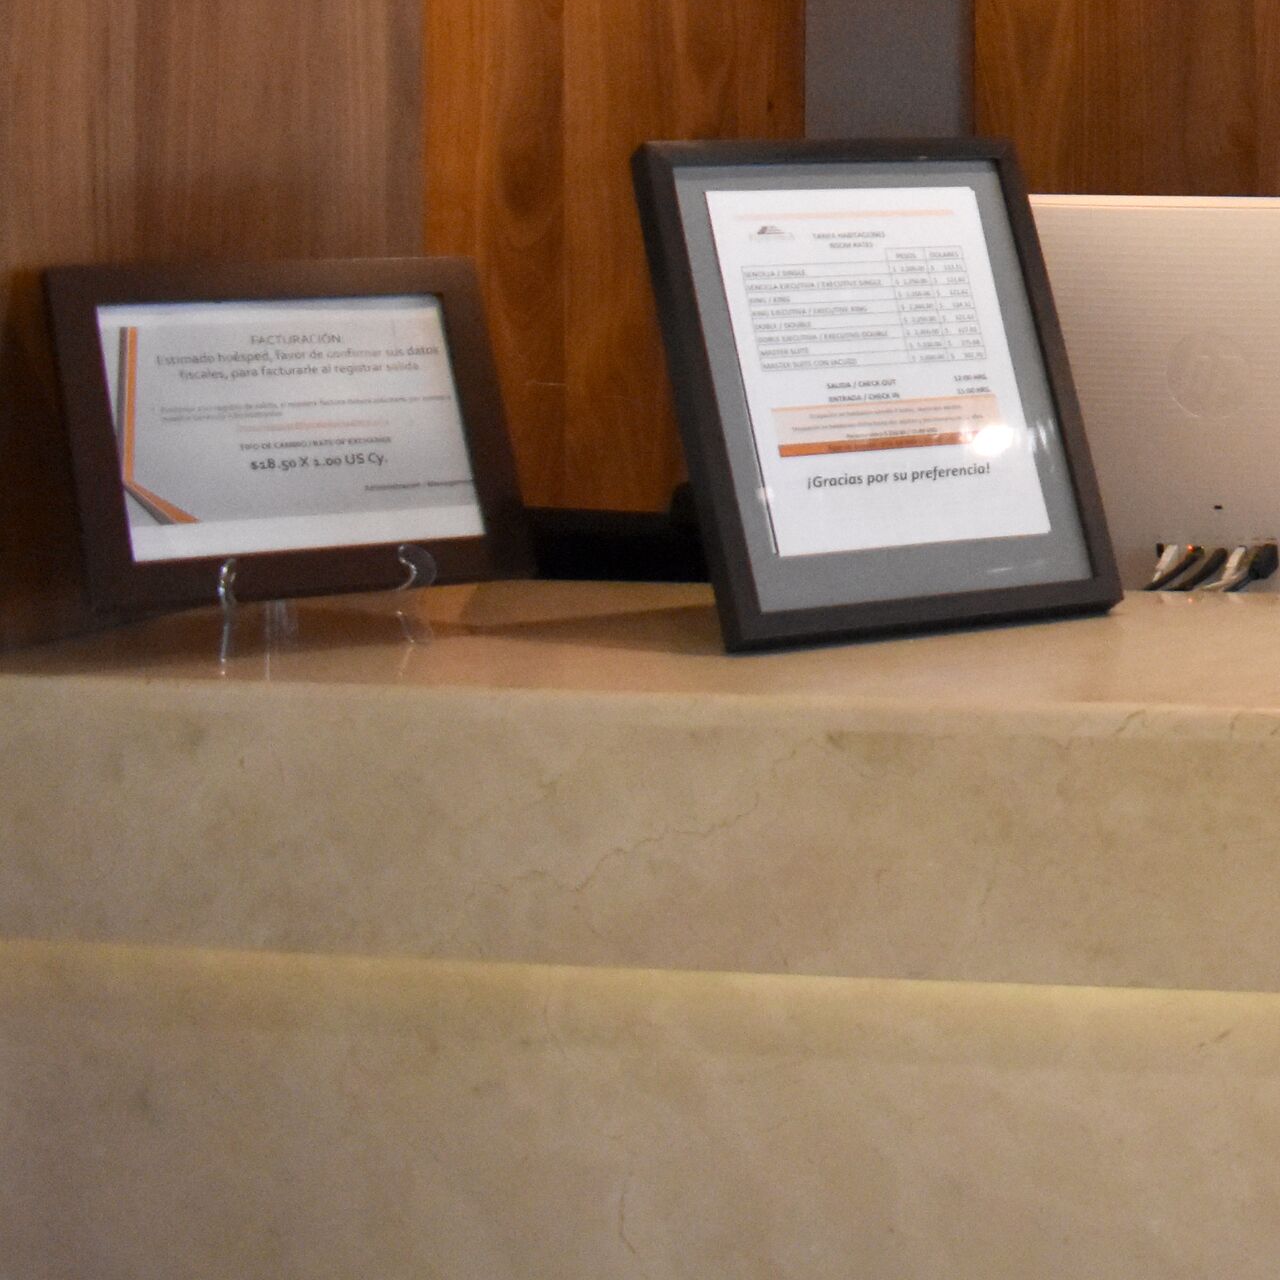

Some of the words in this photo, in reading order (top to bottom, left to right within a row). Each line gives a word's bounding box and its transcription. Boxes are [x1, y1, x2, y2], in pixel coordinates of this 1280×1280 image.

[309, 349, 323, 360] de
[345, 453, 365, 466] US
[807, 474, 863, 490] ¡Gracias
[866, 473, 889, 487] por
[893, 471, 908, 481] su
[911, 462, 991, 482] preferencia!
